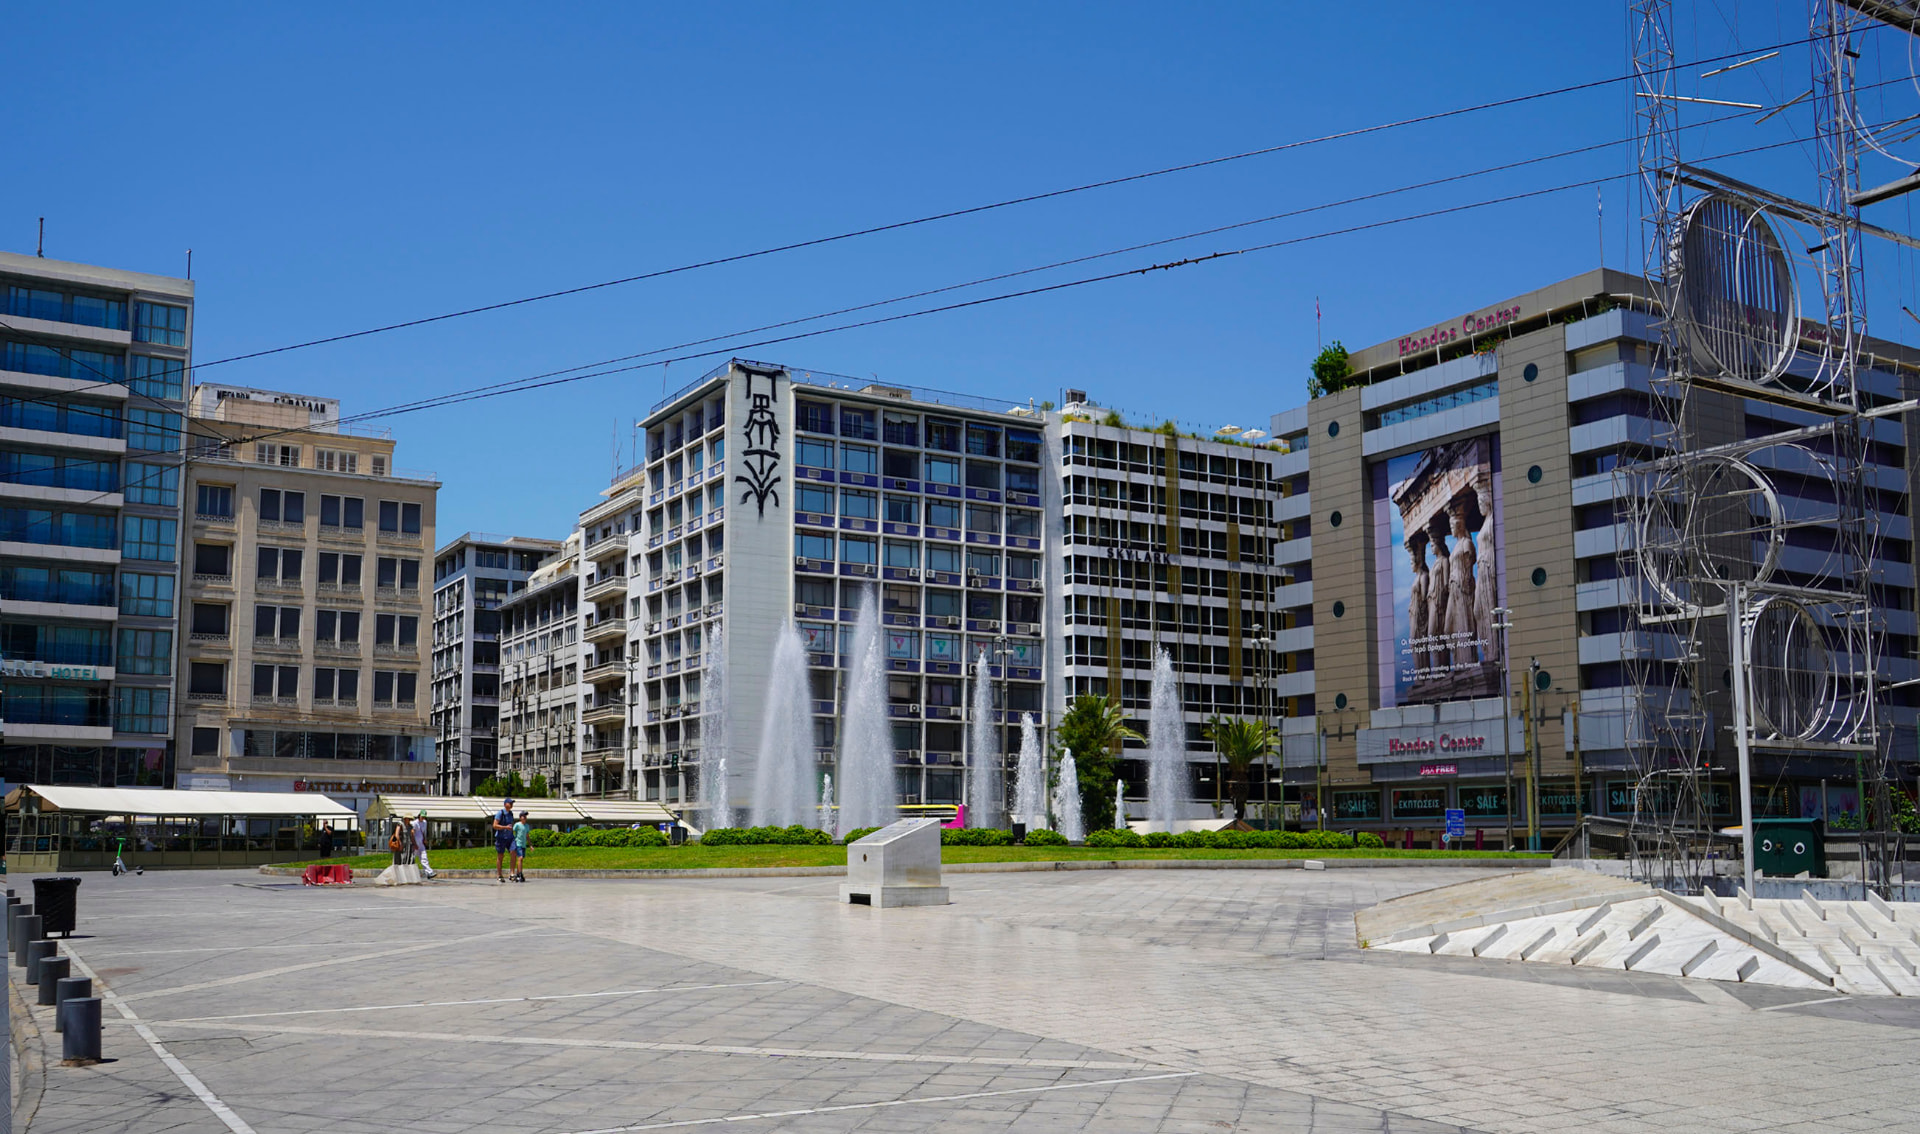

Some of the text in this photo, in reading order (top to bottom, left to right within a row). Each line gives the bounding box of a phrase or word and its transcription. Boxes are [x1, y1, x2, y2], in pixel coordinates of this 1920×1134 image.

[1398, 305, 1521, 356] Hondos Center
[1107, 547, 1171, 564] SKYLARK
[51, 667, 100, 680] HOTEL
[1389, 733, 1485, 753] Hondos Center
[1435, 764, 1456, 773] FREE
[1347, 799, 1367, 812] SALE
[1398, 799, 1440, 809] ΕΚΠΤΩΣΕΙΣ
[1476, 795, 1498, 809] SALE
